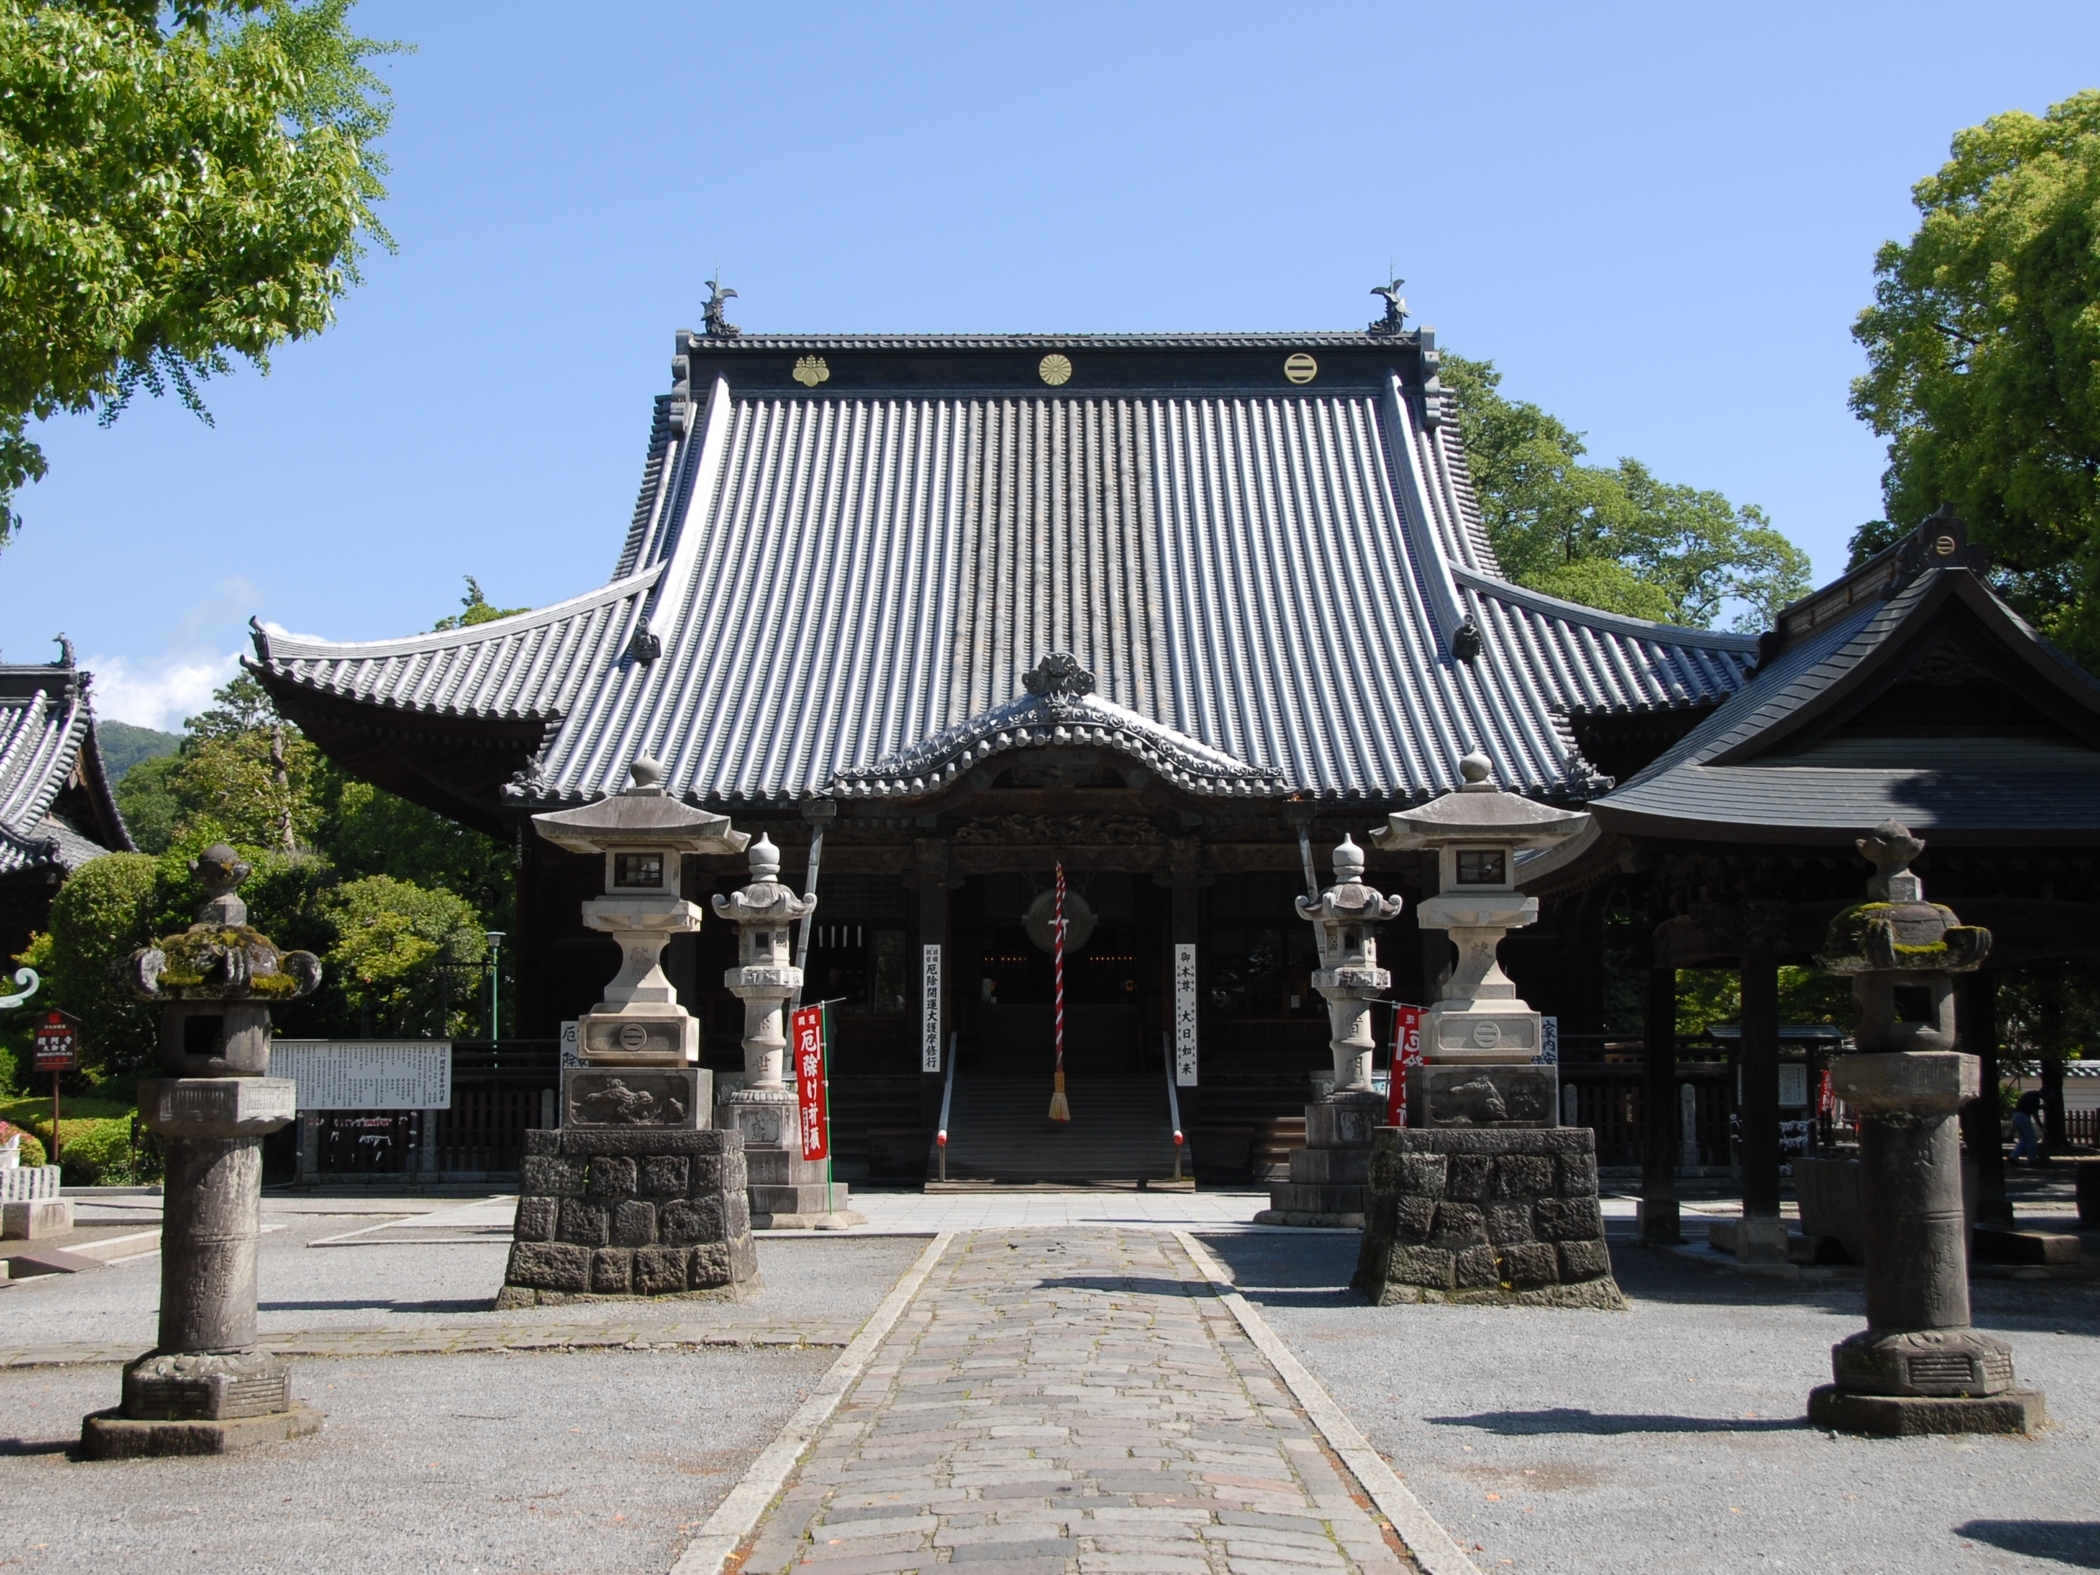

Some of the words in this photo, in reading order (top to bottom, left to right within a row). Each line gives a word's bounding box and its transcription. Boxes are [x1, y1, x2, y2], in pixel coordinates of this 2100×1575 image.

[1180, 951, 1191, 992] 御本尊
[926, 963, 938, 1068] 厄除開運大護摩修行
[1181, 1010, 1192, 1075] 大日如来
[800, 1028, 820, 1150] 厄除け祈願
